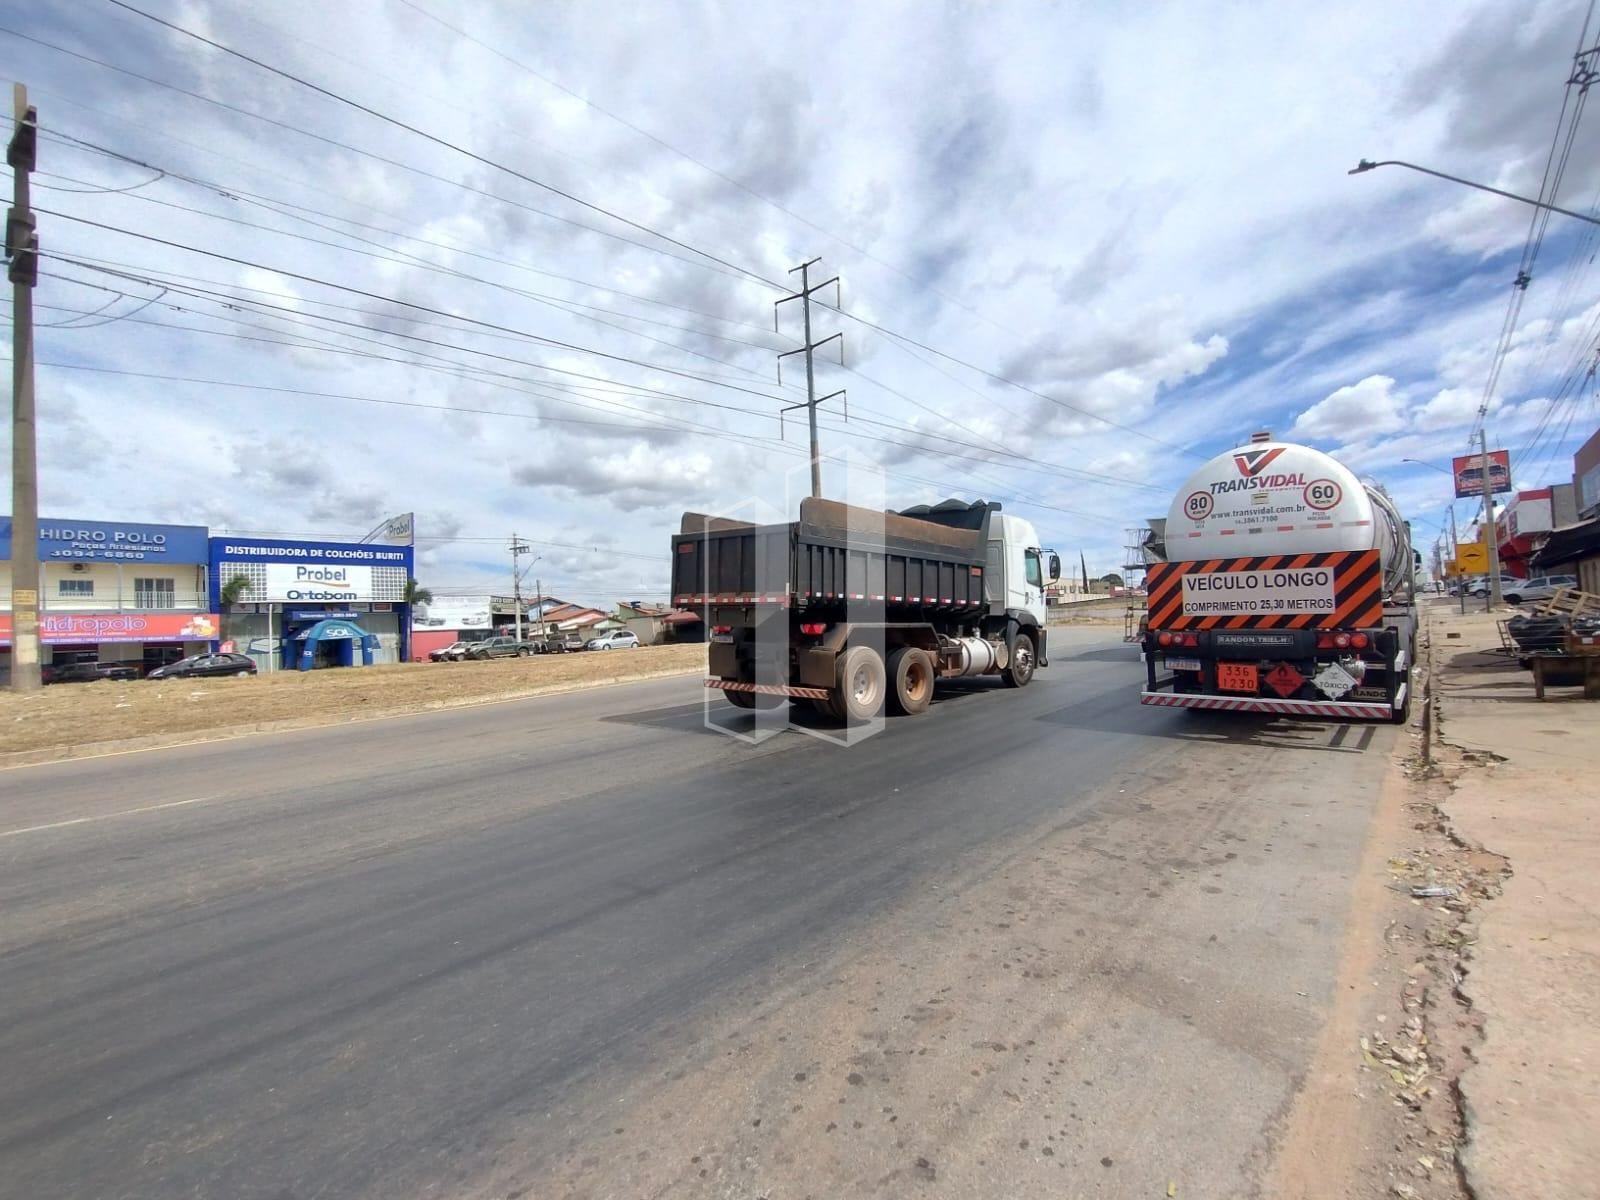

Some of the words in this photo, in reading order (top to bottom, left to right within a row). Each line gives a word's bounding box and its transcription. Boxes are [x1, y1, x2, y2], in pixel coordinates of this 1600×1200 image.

[1210, 473, 1307, 495] TRANSVIDAL
[1312, 485, 1334, 499] 60
[1190, 496, 1208, 510] 80
[1210, 504, 1307, 520] www.transvidal.com.br
[388, 519, 410, 536] Probel
[40, 528, 106, 542] HIDRO
[114, 531, 166, 544] POLO
[225, 545, 308, 557] DISTRIBUIDORA
[310, 549, 323, 558] DE
[325, 549, 374, 560] COLCHÕES
[376, 552, 404, 561] BURITI
[296, 566, 346, 581] Probel
[1187, 574, 1258, 591] VEÍCULO
[1263, 571, 1328, 588] LONGO
[286, 590, 358, 601] Ortobom
[1184, 600, 1257, 612] COMPRIMENTO
[1260, 599, 1284, 611] 25,30
[1287, 598, 1333, 609] METROS
[326, 628, 354, 637] SOL
[1226, 666, 1249, 676] 336
[1224, 678, 1254, 689] 1230
